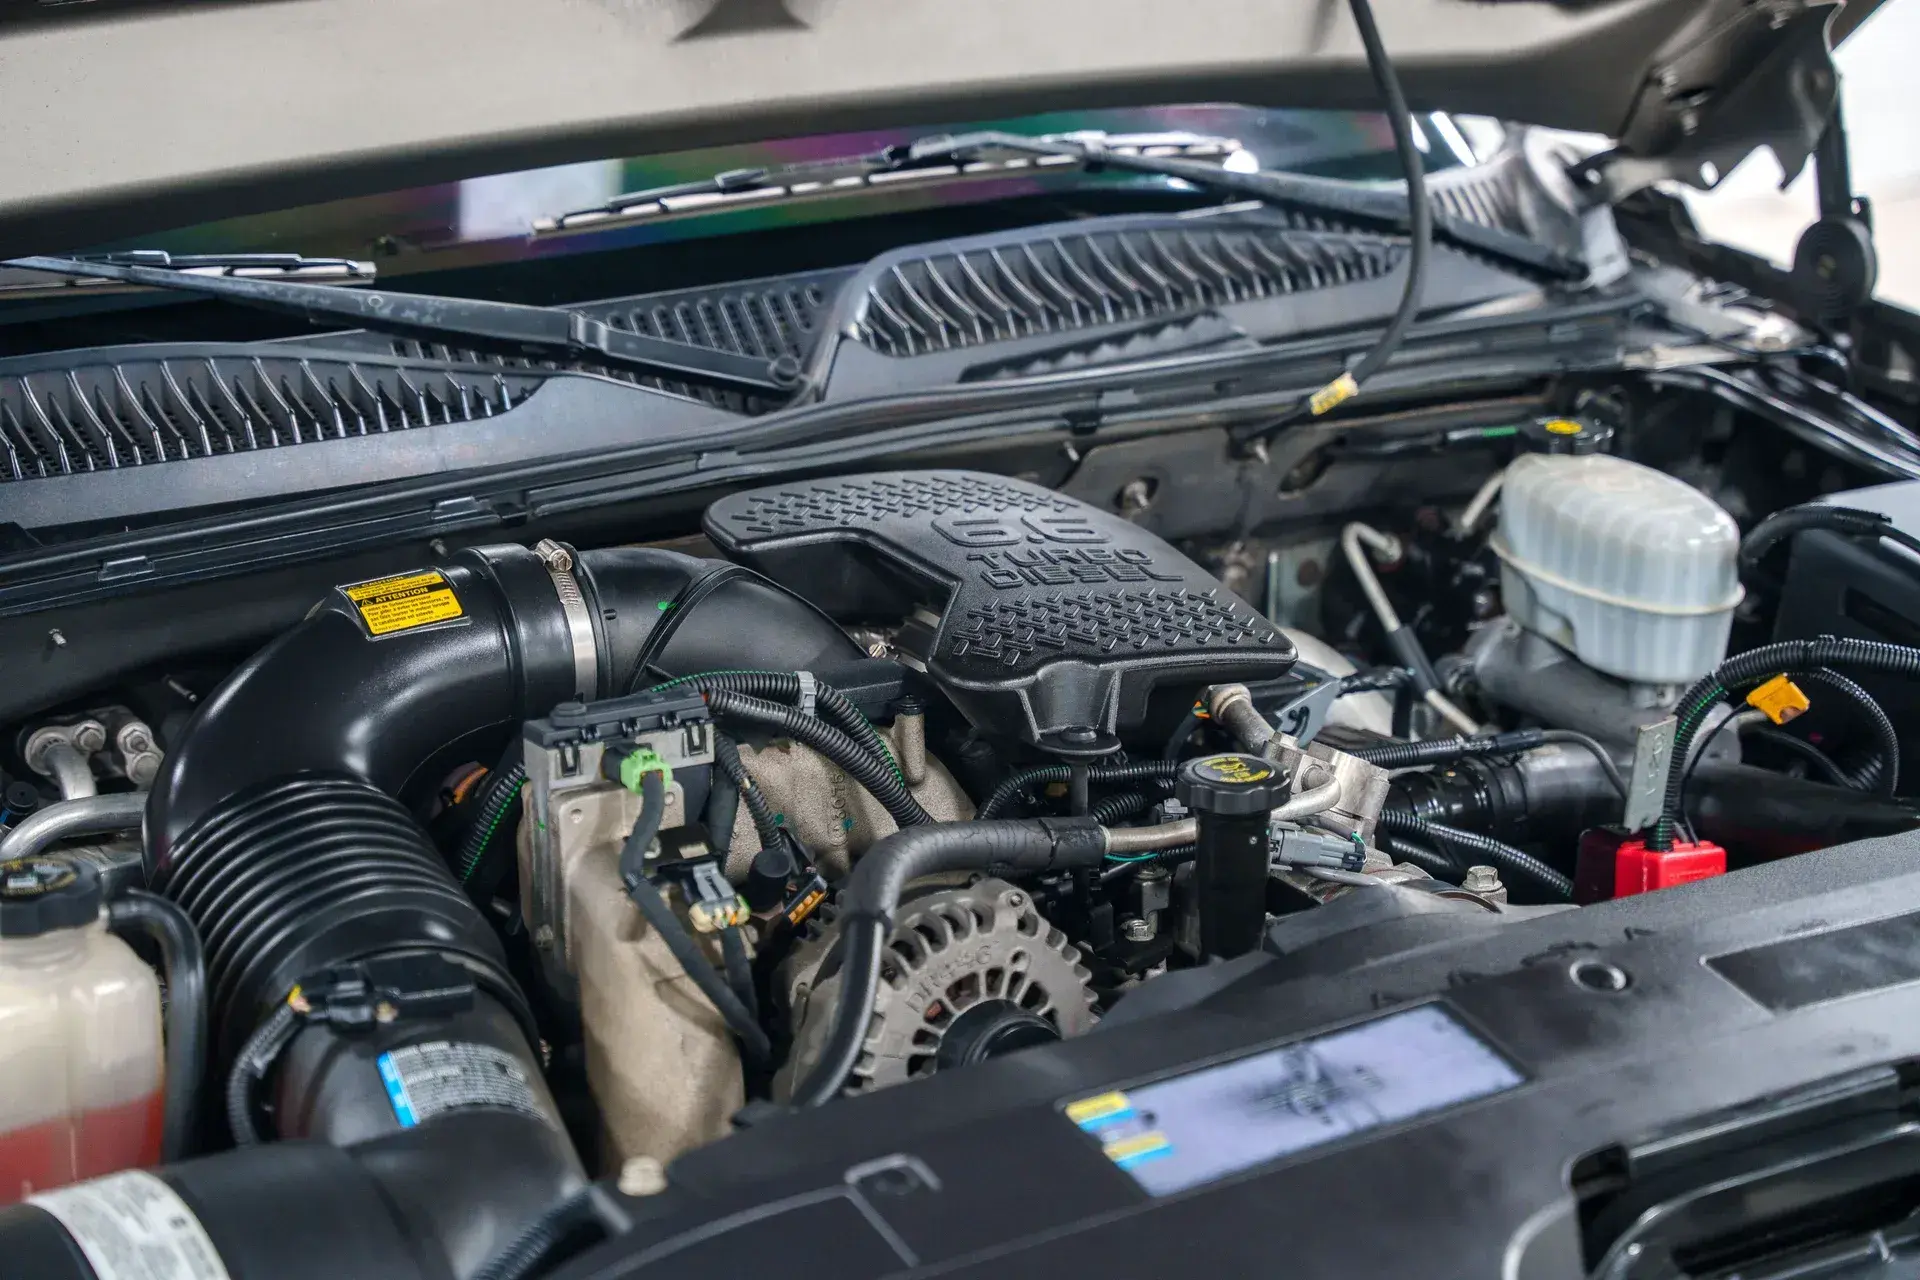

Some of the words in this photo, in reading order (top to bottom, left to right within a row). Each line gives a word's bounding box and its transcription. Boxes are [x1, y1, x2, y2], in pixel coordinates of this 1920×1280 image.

[930, 515, 1113, 547] 6.6
[967, 548, 1154, 569] TURBO
[361, 576, 403, 588] CAUTION
[980, 564, 1184, 589] DIESEL
[375, 587, 428, 603] ATTENTION
